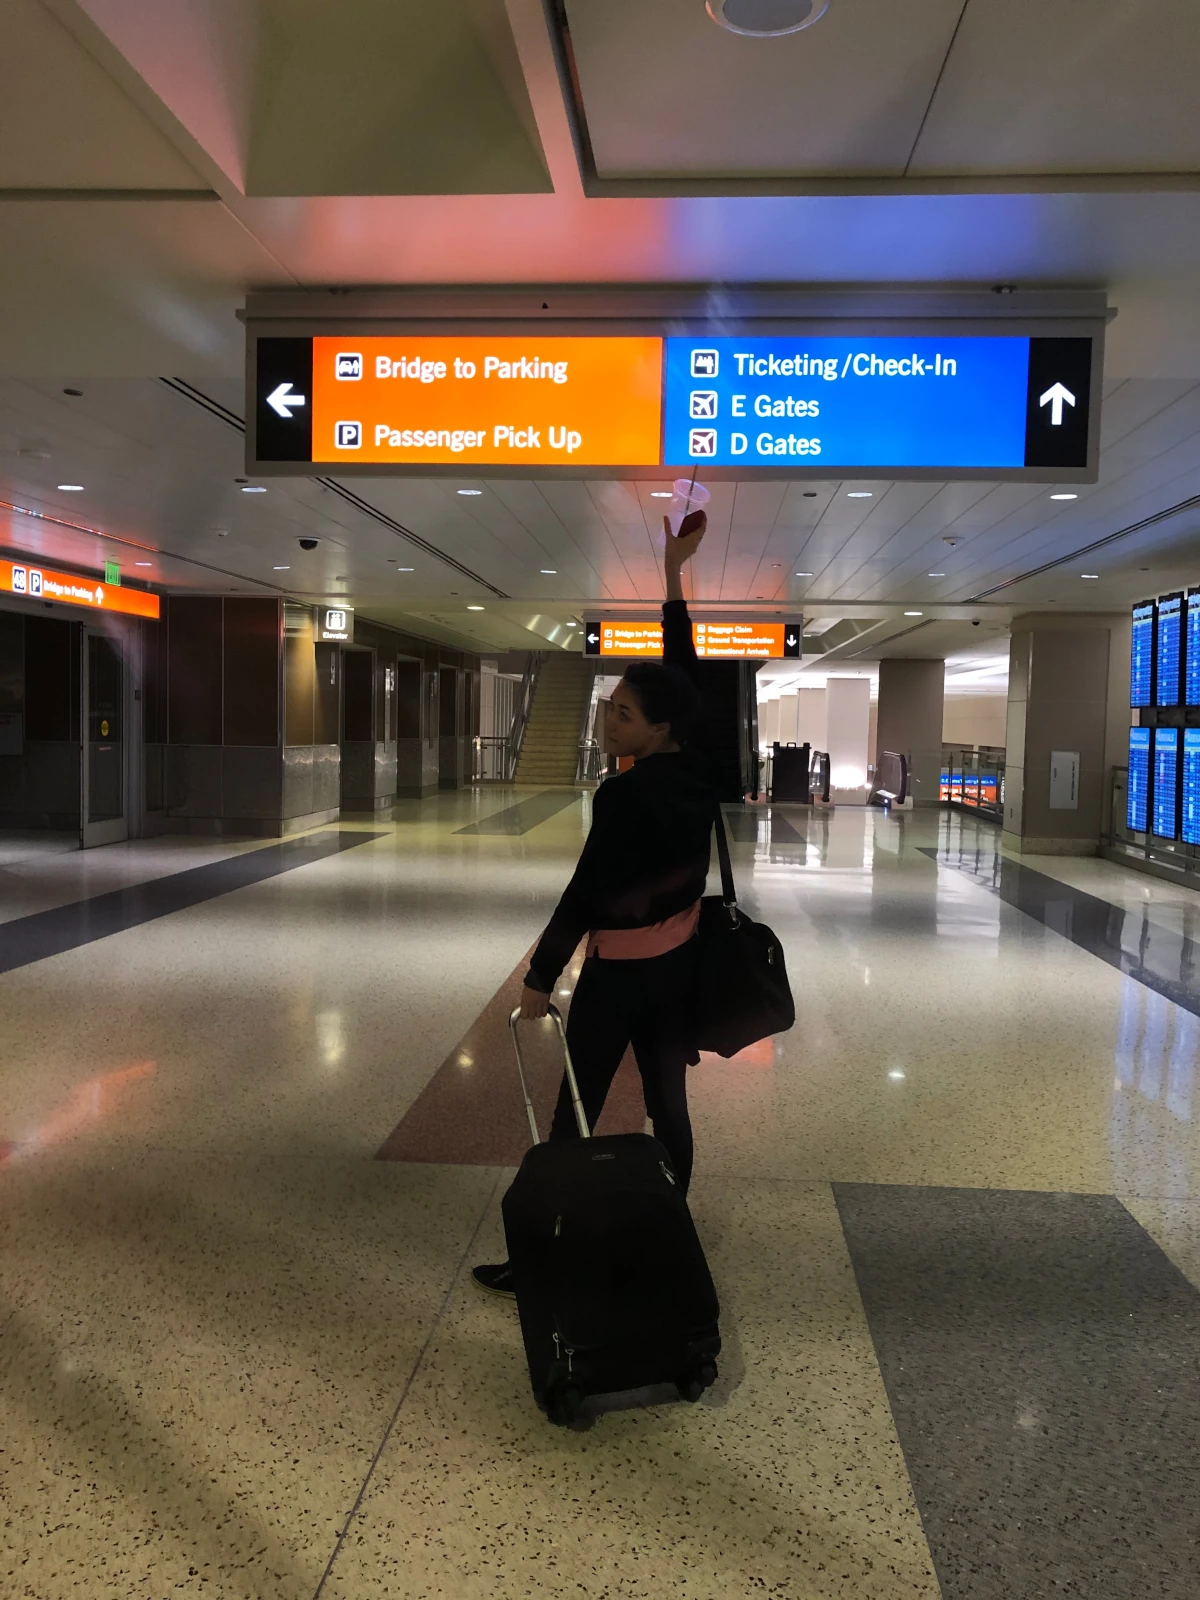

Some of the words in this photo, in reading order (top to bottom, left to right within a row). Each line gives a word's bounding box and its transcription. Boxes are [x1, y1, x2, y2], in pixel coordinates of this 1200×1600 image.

[375, 356, 447, 383] Bridge
[453, 357, 476, 379] to
[484, 356, 568, 384] Parking
[731, 395, 747, 417] E
[754, 394, 820, 418] Gates
[374, 424, 487, 452] Passenger
[493, 425, 541, 448] Pick
[548, 426, 582, 453] Up
[730, 432, 748, 455] D
[756, 432, 822, 456] Gates
[322, 631, 348, 640] Elevator
